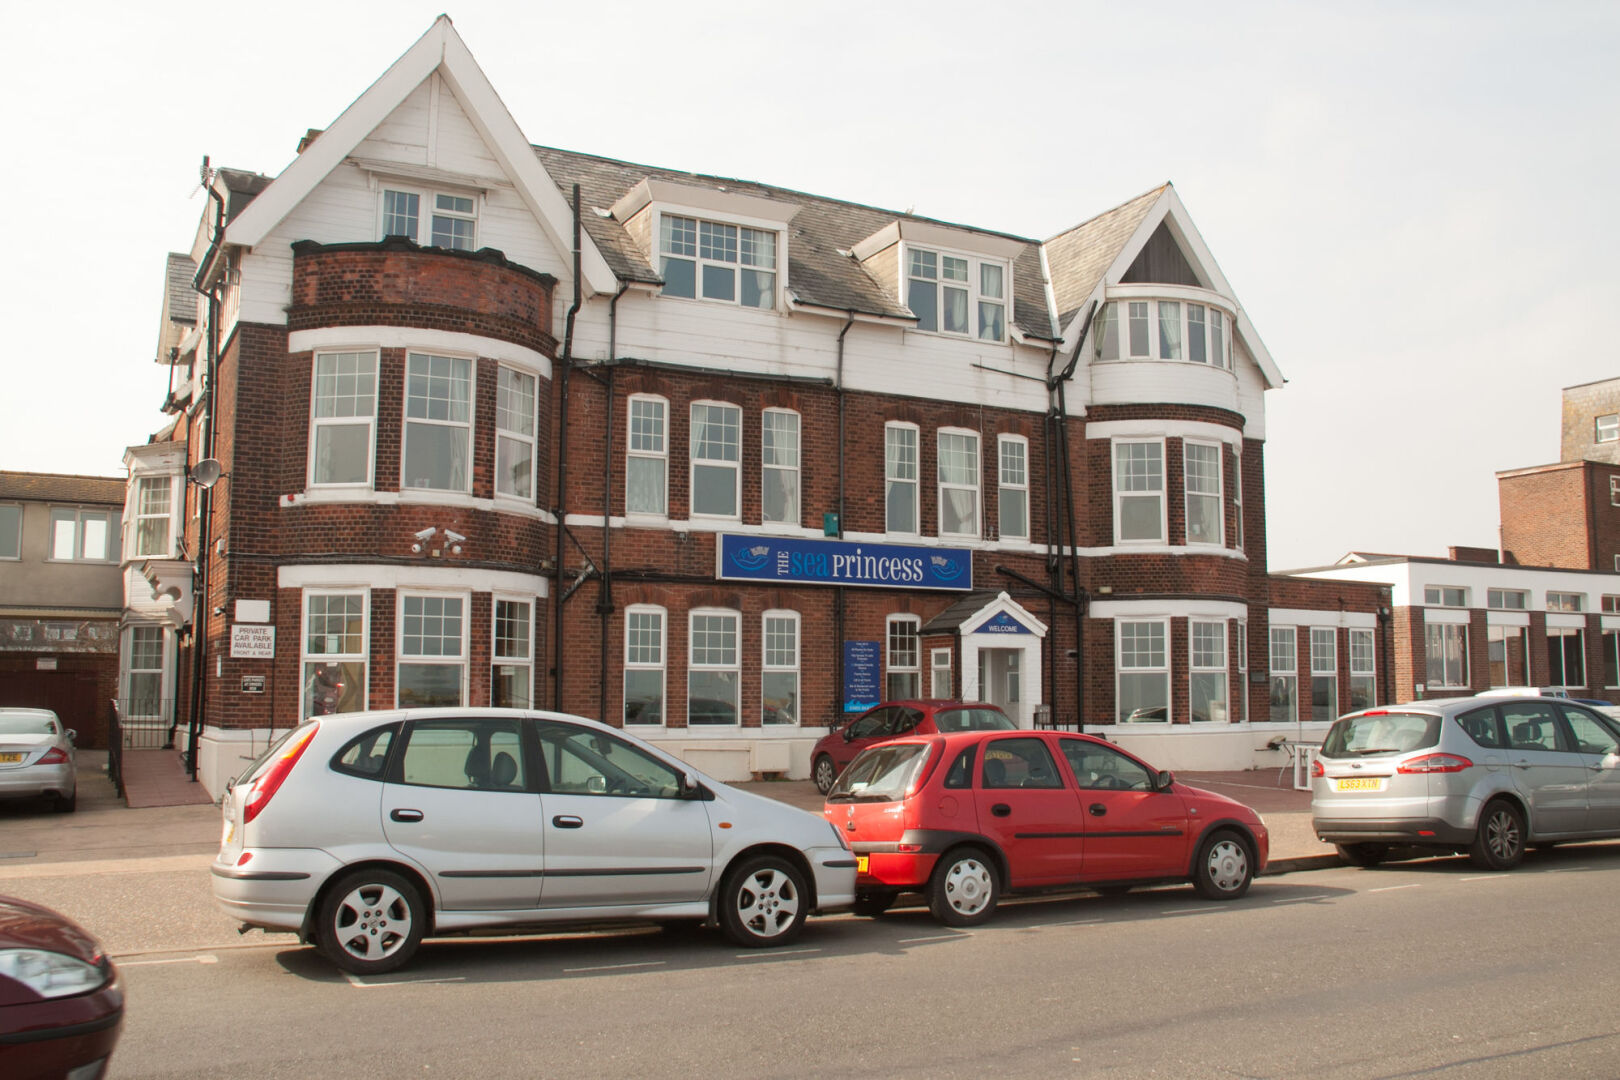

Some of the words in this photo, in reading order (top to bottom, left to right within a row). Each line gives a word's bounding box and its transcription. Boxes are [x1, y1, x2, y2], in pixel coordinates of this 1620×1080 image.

[777, 551, 789, 576] THE
[791, 551, 829, 577] sea
[832, 548, 923, 582] Princess
[239, 627, 268, 635] PRIVATE
[234, 642, 272, 650] AVAILABLE
